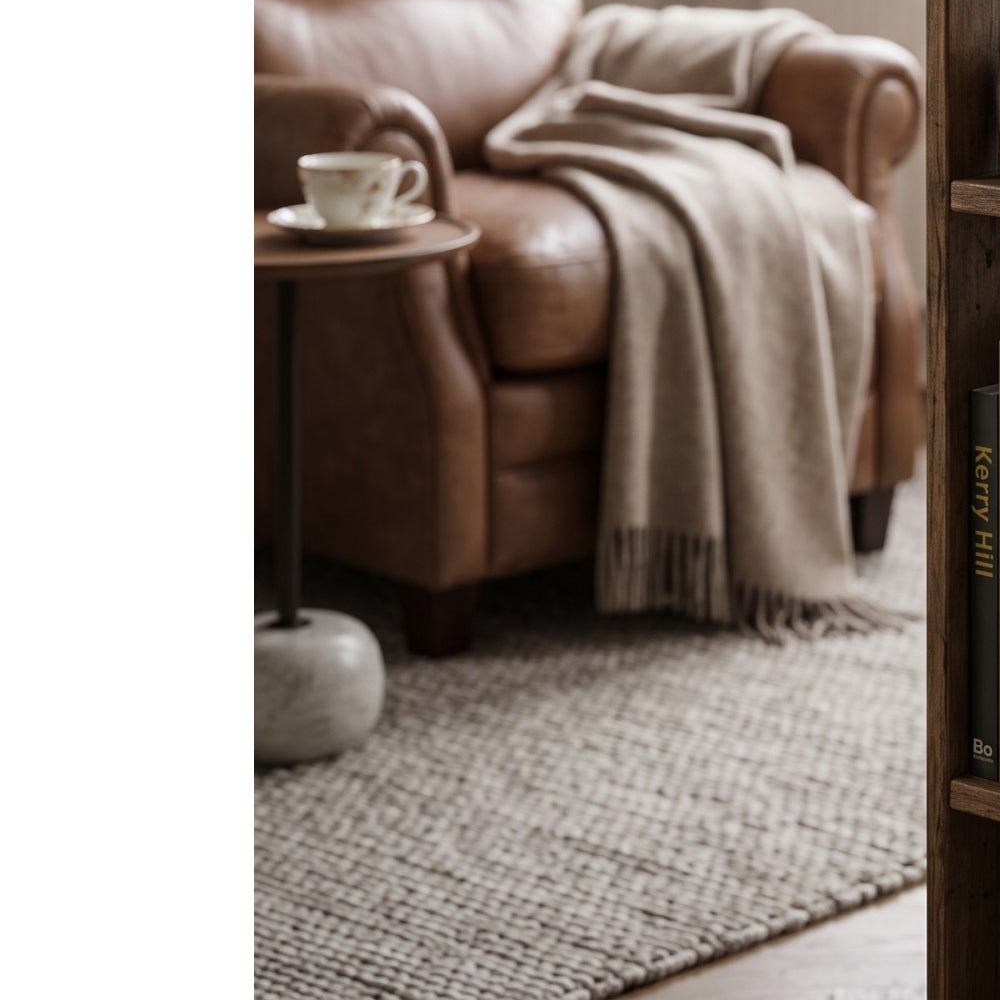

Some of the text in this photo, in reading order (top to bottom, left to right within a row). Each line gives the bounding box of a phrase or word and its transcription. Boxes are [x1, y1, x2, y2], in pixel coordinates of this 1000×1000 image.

[972, 445, 994, 578] Kerry Hill
[973, 738, 993, 757] Bo
